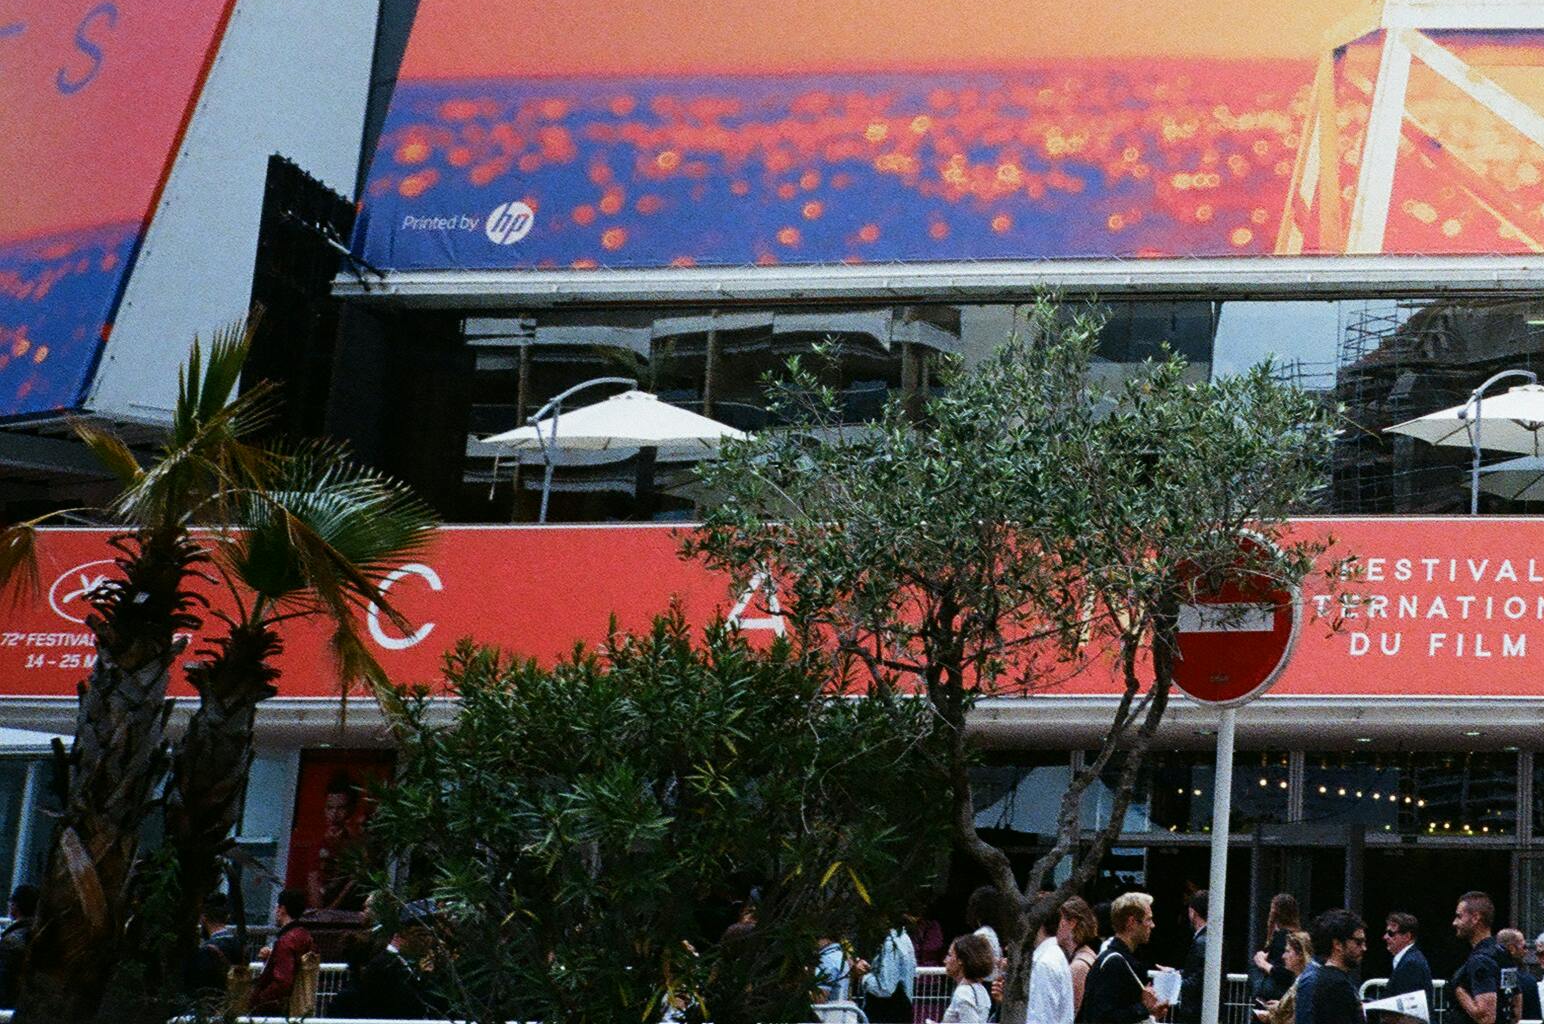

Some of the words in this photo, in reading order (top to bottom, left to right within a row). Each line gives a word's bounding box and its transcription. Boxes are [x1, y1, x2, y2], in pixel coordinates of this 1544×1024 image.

[402, 213, 457, 230] Printed
[459, 212, 480, 231] by
[1349, 632, 1402, 657] DU
[1428, 632, 1529, 658] FILM
[25, 653, 45, 669] 14
[59, 653, 81, 669] 25
